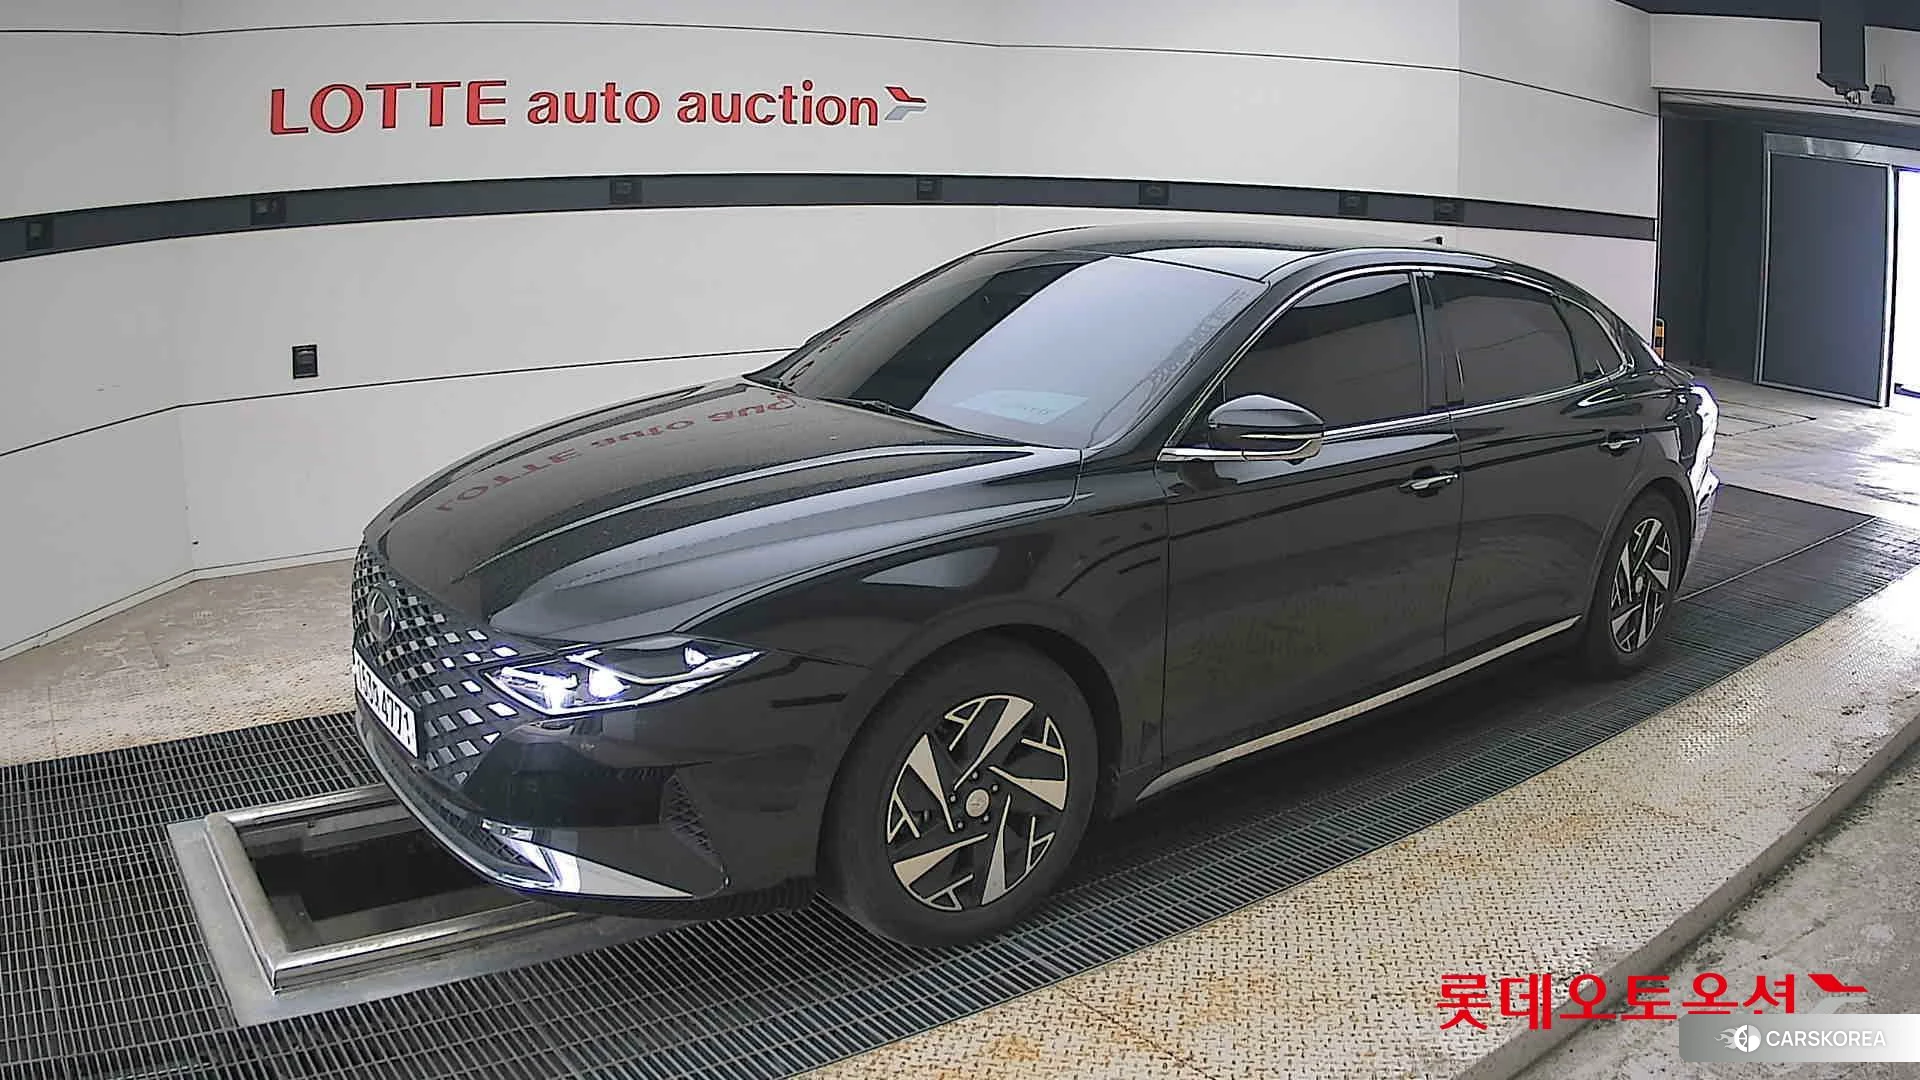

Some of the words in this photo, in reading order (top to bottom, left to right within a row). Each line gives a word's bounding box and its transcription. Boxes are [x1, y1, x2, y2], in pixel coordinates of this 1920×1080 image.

[270, 79, 507, 135] LOTTE
[526, 81, 661, 125] auto
[676, 79, 879, 127] auction
